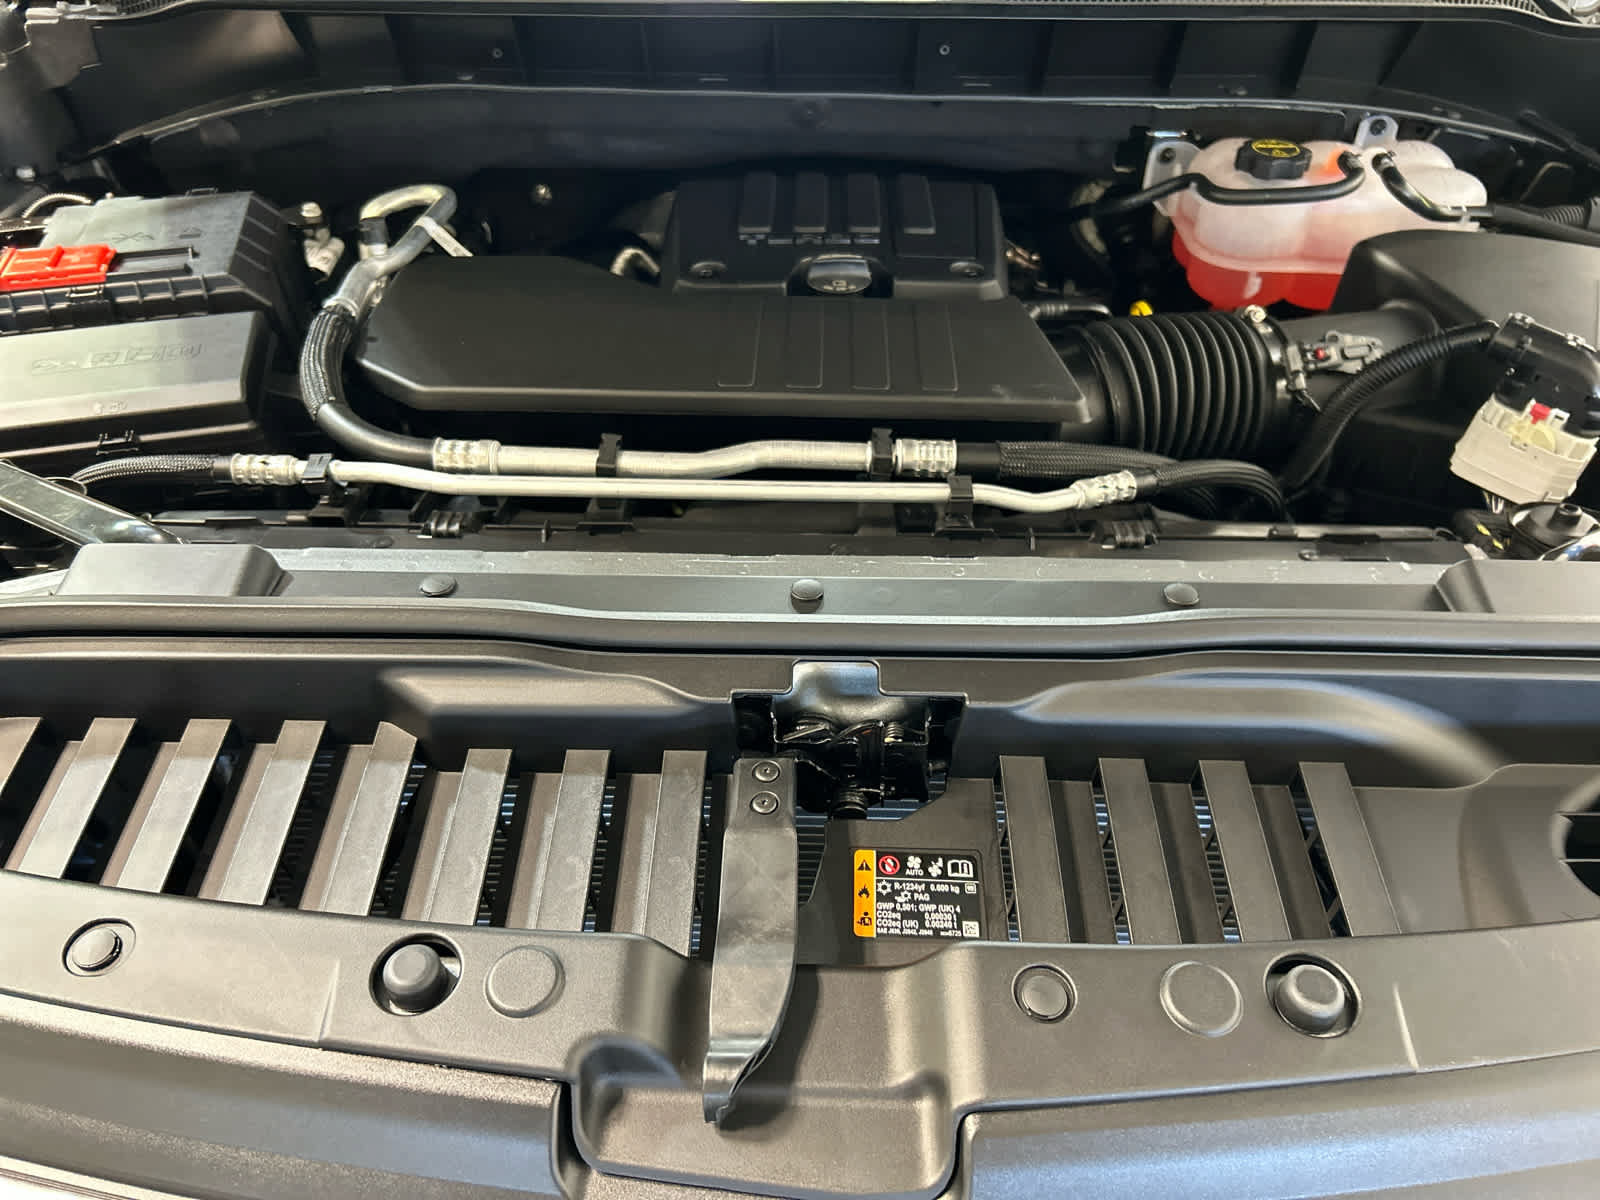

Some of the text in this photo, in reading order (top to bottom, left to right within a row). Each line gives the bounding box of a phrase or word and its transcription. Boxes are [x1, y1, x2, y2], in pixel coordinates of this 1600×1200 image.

[894, 883, 925, 893] R-1234yf
[950, 884, 960, 895] kg
[914, 893, 930, 901] PAG
[877, 902, 895, 911] GWP
[919, 904, 937, 912] GWP
[938, 905, 954, 914] (UK)
[955, 905, 961, 913] 4
[877, 910, 902, 920] CO2eq
[877, 919, 902, 928] CO2eq
[902, 919, 919, 929] (UK)
